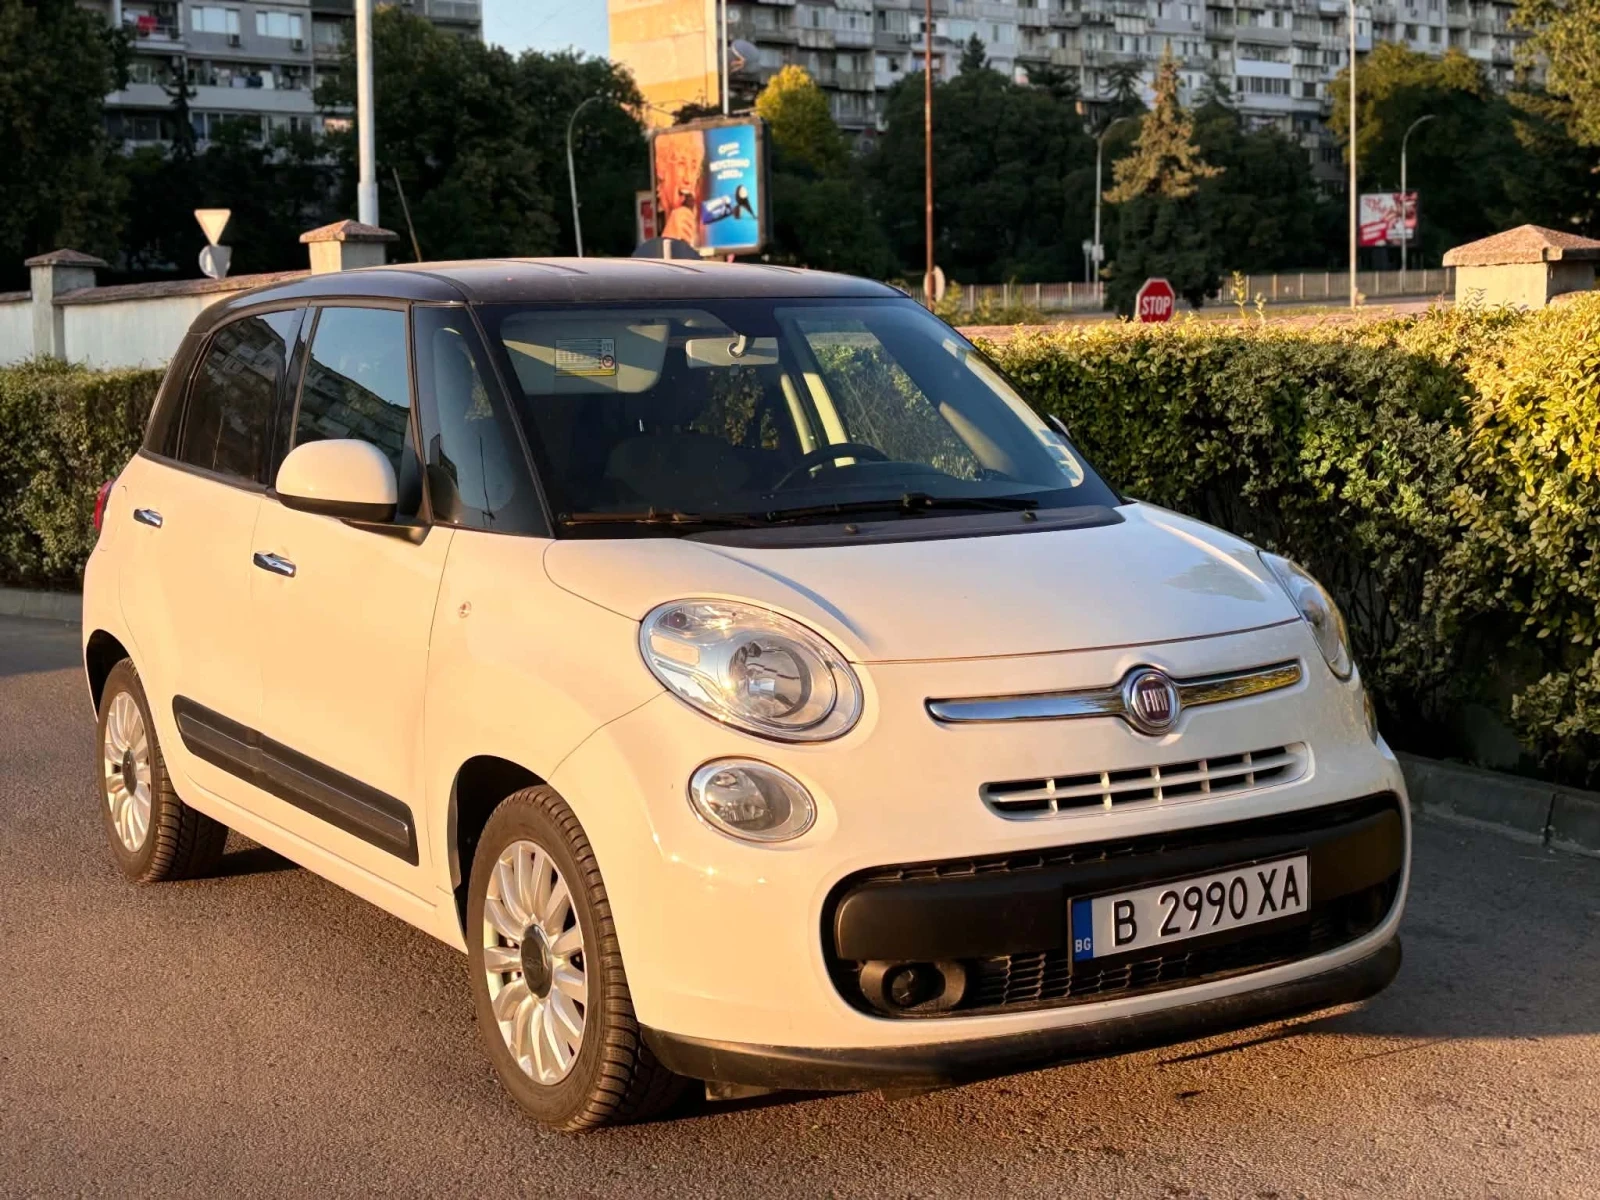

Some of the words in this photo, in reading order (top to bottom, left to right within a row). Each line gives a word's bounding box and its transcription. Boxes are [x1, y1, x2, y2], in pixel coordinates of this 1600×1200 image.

[1142, 296, 1171, 315] STOP
[1142, 688, 1168, 713] FIAT
[1112, 899, 1137, 947] B
[1158, 876, 1247, 937] 2990
[1257, 865, 1301, 916] XA
[1074, 937, 1092, 953] BG
